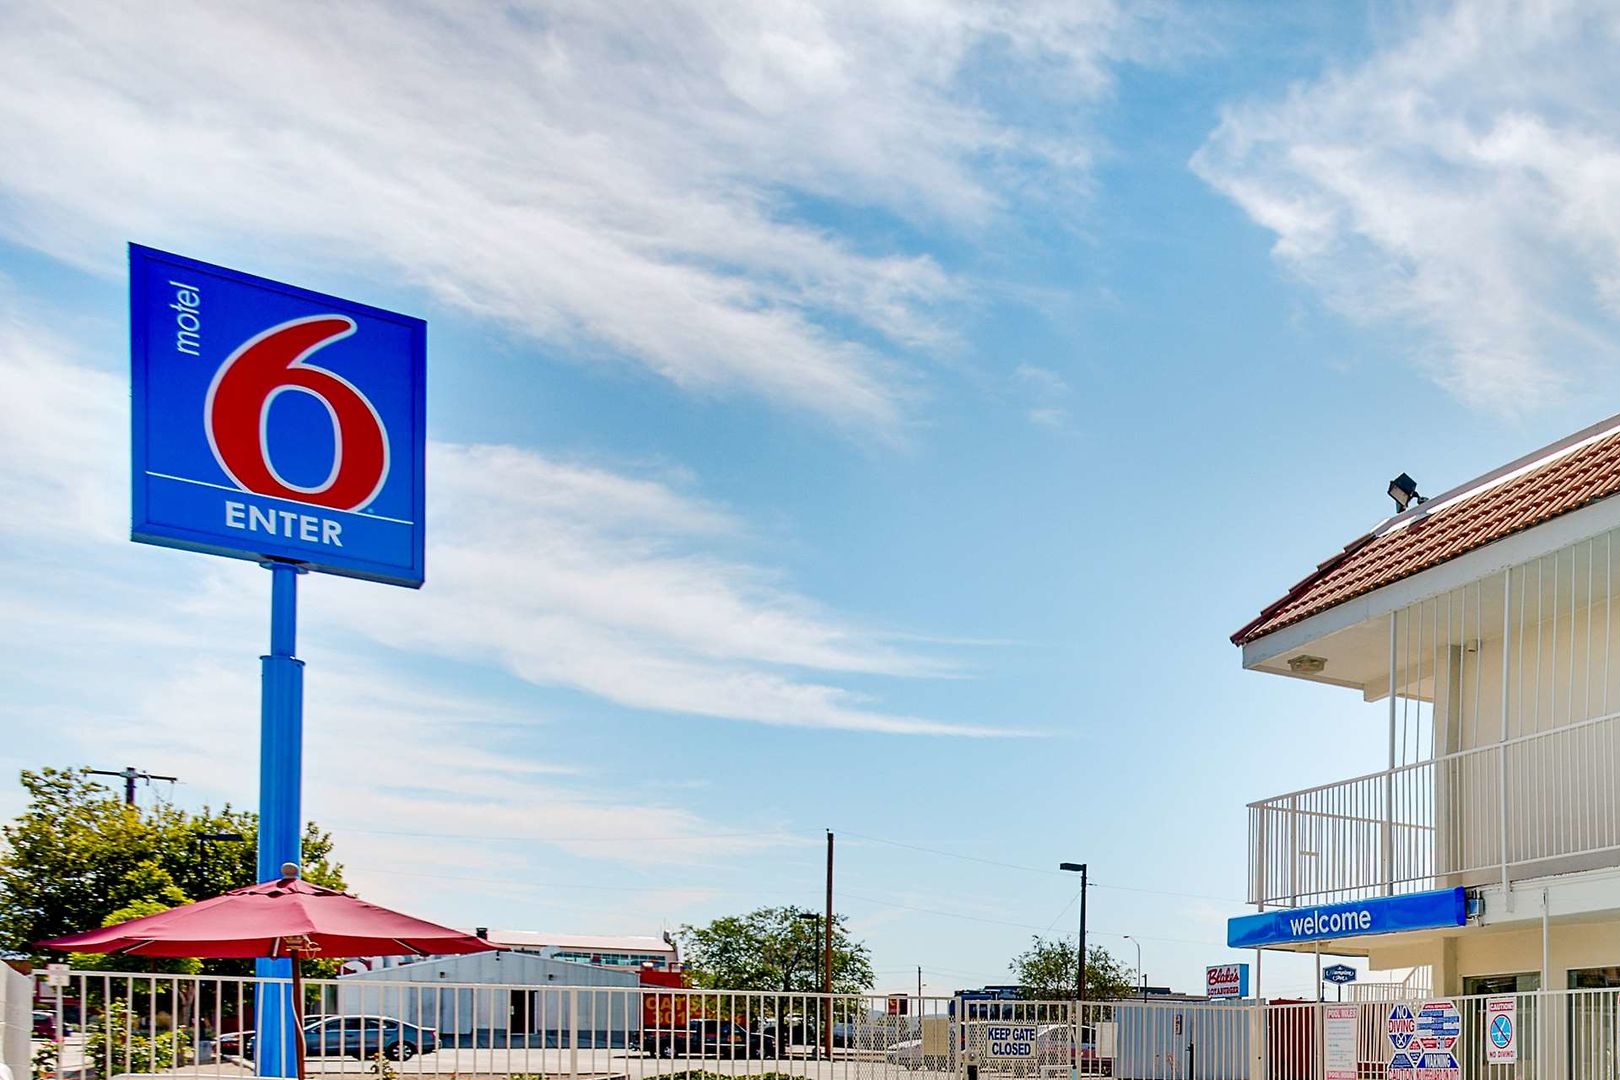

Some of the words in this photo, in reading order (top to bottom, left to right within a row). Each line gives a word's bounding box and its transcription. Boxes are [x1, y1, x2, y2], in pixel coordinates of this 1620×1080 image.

[169, 281, 200, 356] motel
[204, 314, 391, 514] 6
[225, 500, 344, 547] ENTER
[1290, 910, 1372, 937] welcome
[1207, 967, 1239, 986] Blake's
[1396, 1005, 1408, 1018] NO
[988, 1027, 1011, 1041] KEEP
[1012, 1027, 1036, 1041] GATE
[1388, 1020, 1415, 1033] DIVING
[991, 1042, 1032, 1056] CLOSED
[1424, 1054, 1451, 1068] WARNING
